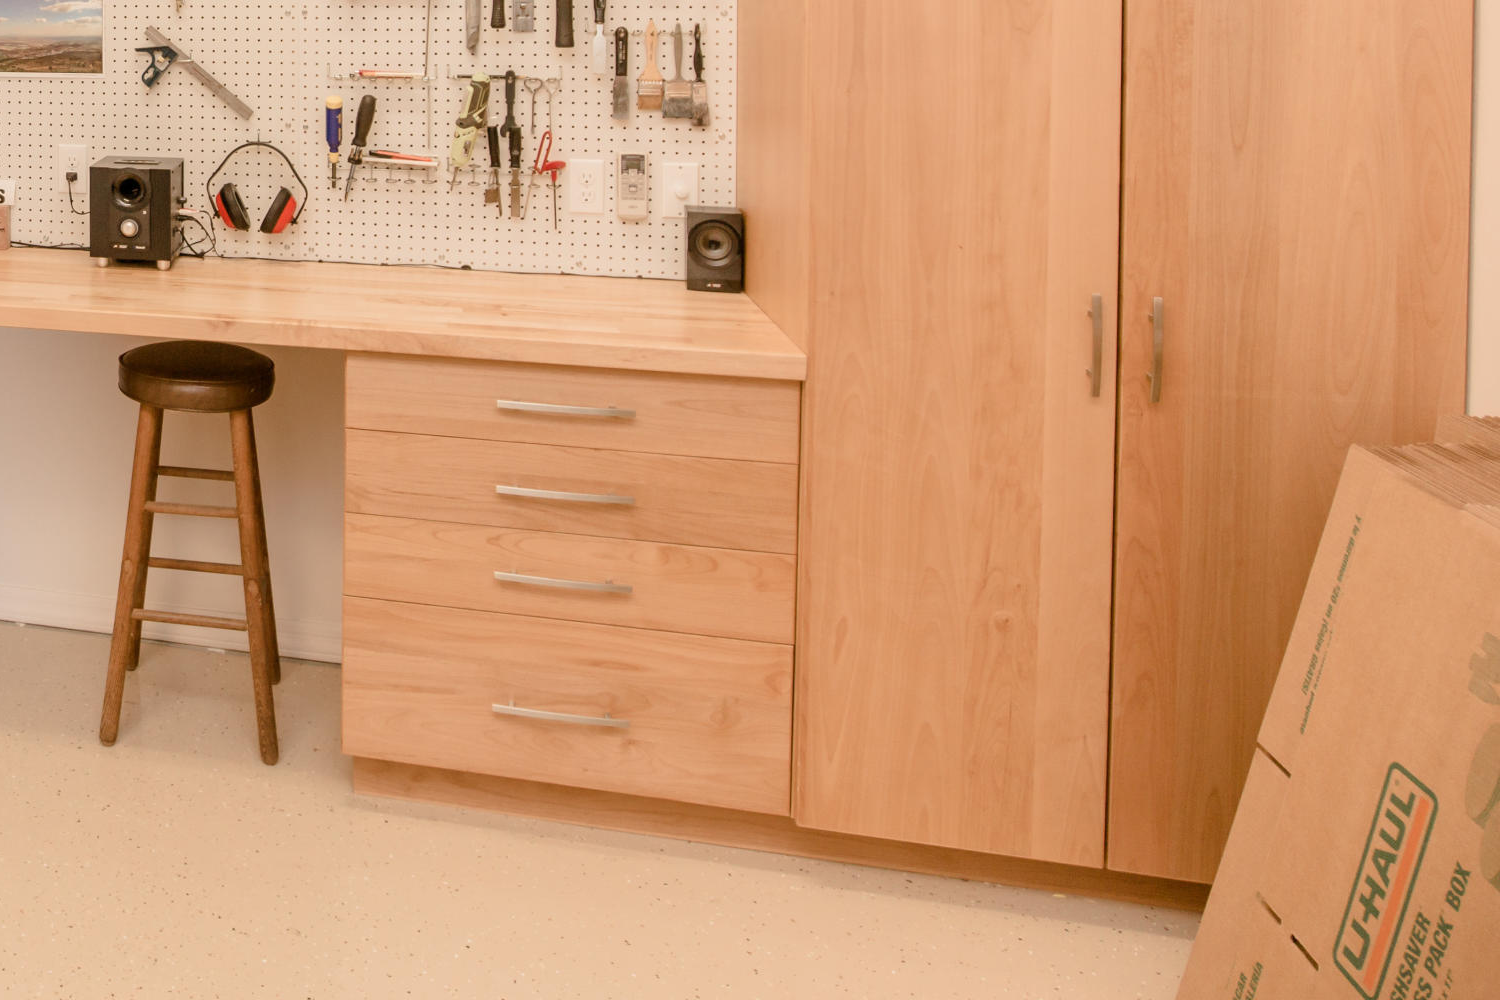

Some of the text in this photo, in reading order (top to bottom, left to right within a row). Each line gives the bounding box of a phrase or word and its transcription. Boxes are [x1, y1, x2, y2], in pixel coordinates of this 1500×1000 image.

[1342, 791, 1416, 971] U-HAUL
[1424, 914, 1455, 979] PACK
[1445, 859, 1472, 913] BOX
